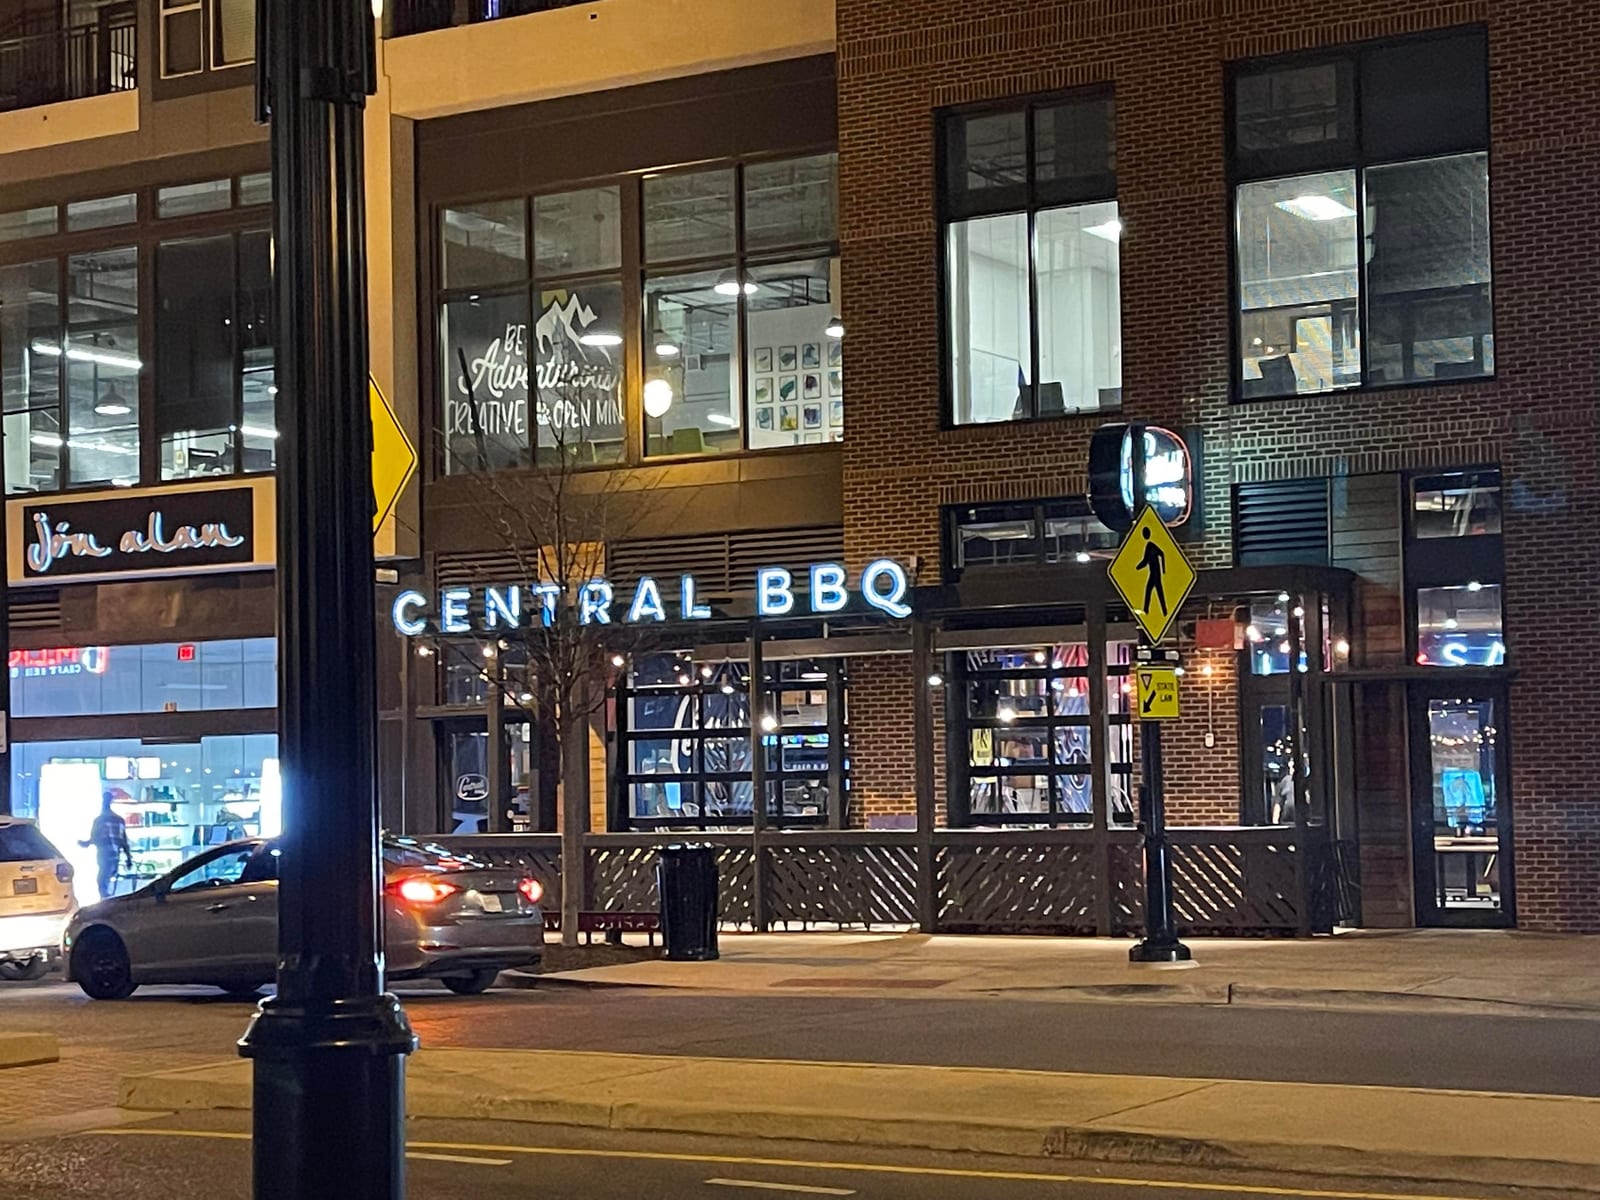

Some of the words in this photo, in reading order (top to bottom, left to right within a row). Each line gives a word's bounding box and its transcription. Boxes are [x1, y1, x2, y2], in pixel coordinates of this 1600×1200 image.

[504, 323, 526, 356] BE
[553, 399, 590, 428] OPEN
[120, 511, 244, 553] alan
[393, 575, 711, 636] CENTRAL
[757, 558, 912, 617] BBQ
